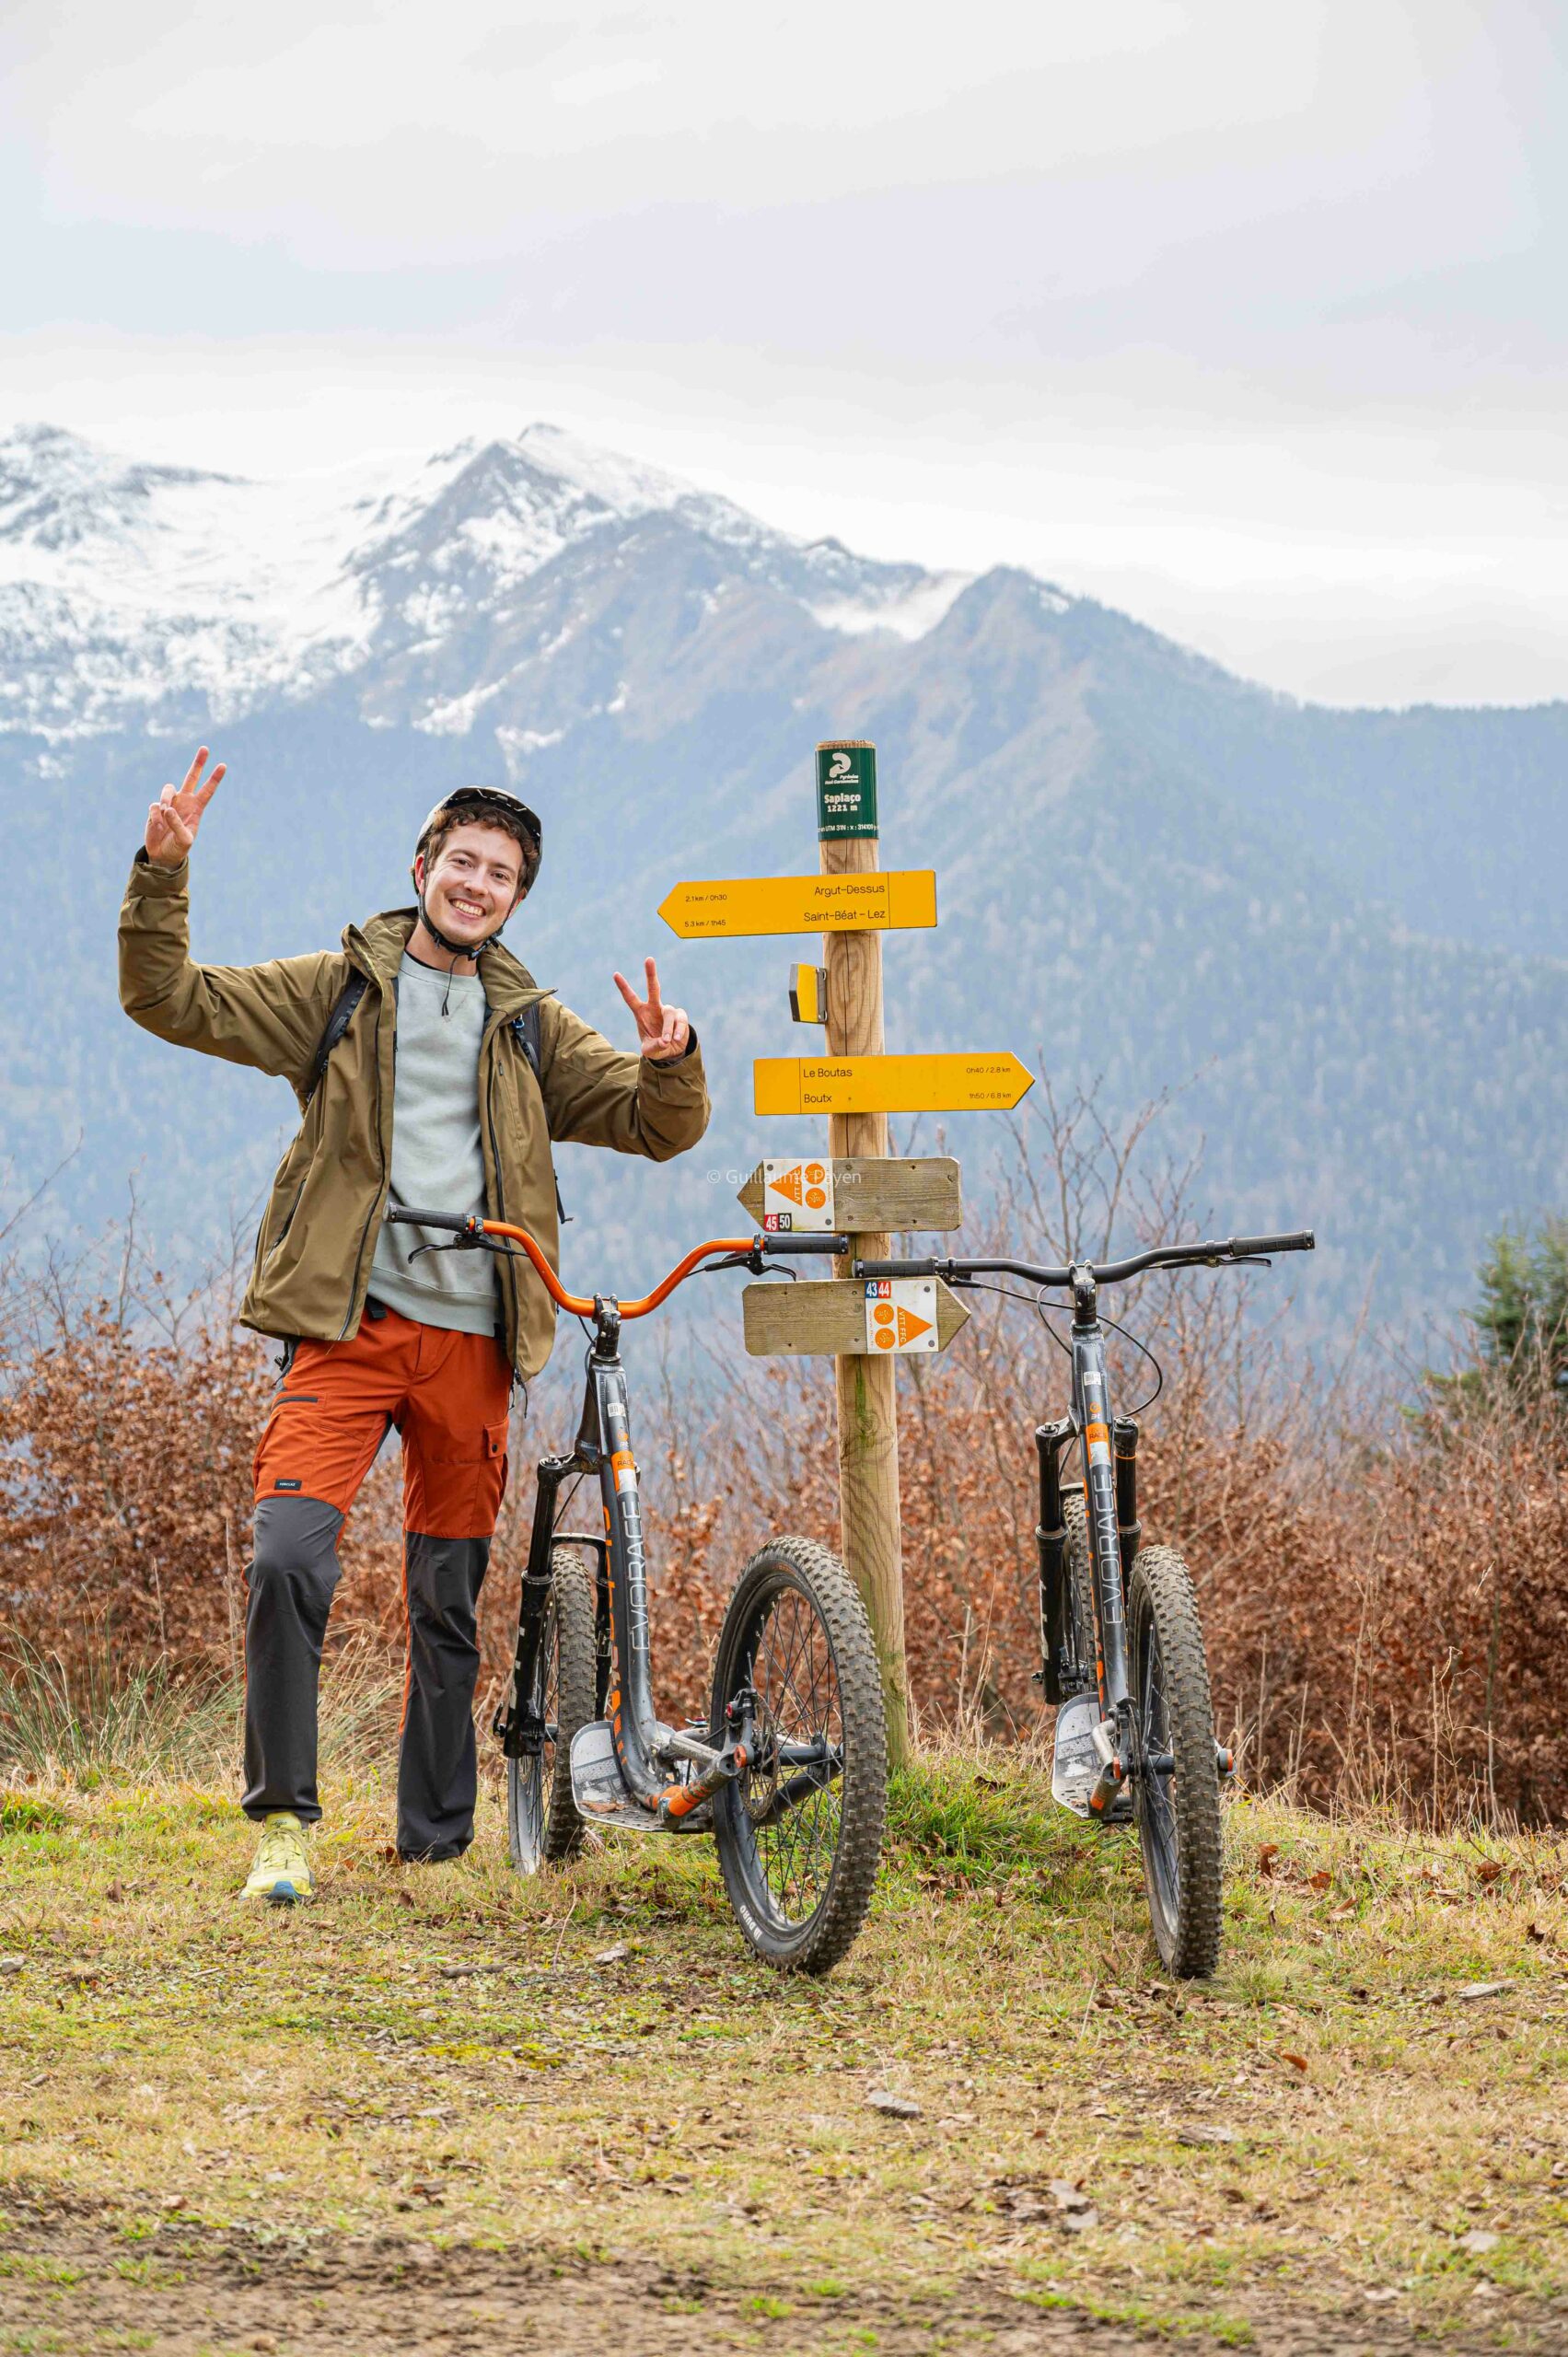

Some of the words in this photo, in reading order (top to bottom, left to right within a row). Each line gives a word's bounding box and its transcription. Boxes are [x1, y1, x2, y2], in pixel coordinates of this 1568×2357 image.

[825, 793, 861, 804] Saplaço
[815, 885, 885, 898] Argut-Dessus
[804, 910, 857, 922] Saint-Béat
[868, 910, 886, 919] Lez
[804, 1069, 815, 1077] Le
[818, 1068, 853, 1077] Boutas
[805, 1094, 831, 1103] Boutx
[766, 1216, 777, 1230] 45
[779, 1215, 790, 1229] 50
[866, 1283, 877, 1296] 43
[878, 1283, 889, 1296] 44
[1094, 1475, 1122, 1624] EVORACE
[622, 1502, 650, 1650] EVORACE
[740, 1905, 756, 1931] DURO
